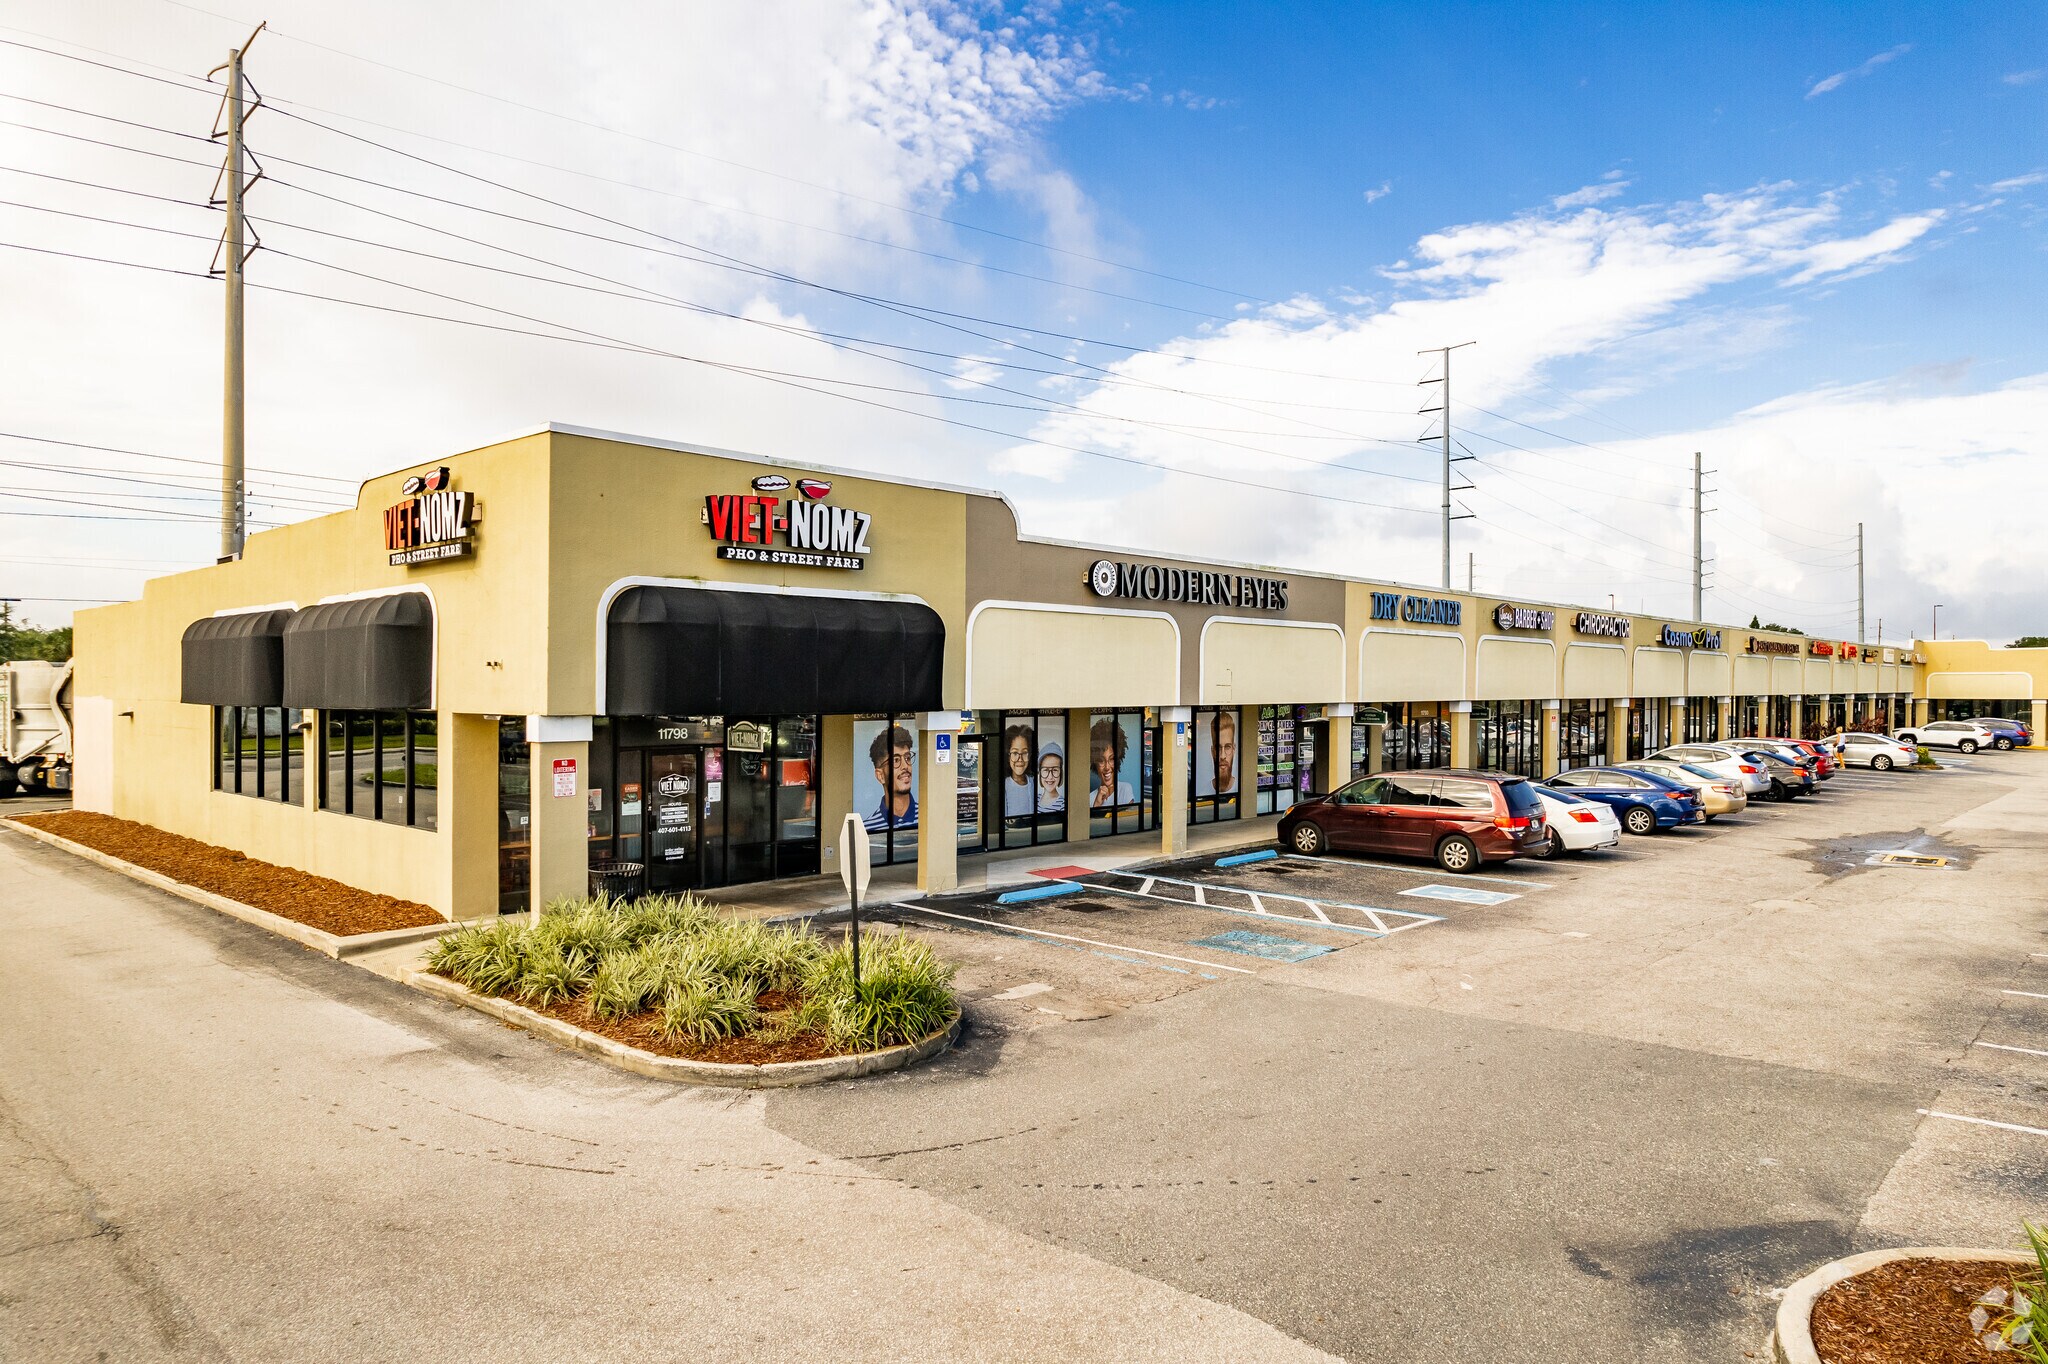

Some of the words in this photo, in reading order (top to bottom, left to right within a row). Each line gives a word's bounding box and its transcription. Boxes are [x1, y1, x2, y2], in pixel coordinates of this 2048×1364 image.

[391, 554, 406, 566] PHO
[412, 547, 440, 562] STREET
[440, 543, 461, 556] FARE
[726, 547, 757, 561] PHO
[759, 551, 769, 561] &
[771, 551, 823, 566] STREET
[826, 558, 860, 570] FARE
[1116, 562, 1234, 606] MODERN
[1235, 575, 1289, 611] EYES
[1371, 592, 1402, 620] DRY
[1403, 595, 1462, 626] CLEANER
[1514, 608, 1537, 630] BARBER
[1579, 613, 1631, 639] CHIROPRACTOR
[1664, 624, 1693, 648] Cosmo
[658, 728, 689, 740] 11798
[660, 781, 672, 791] VIET
[673, 780, 689, 791] NOMZ
[657, 825, 692, 834] 407-601-4113
